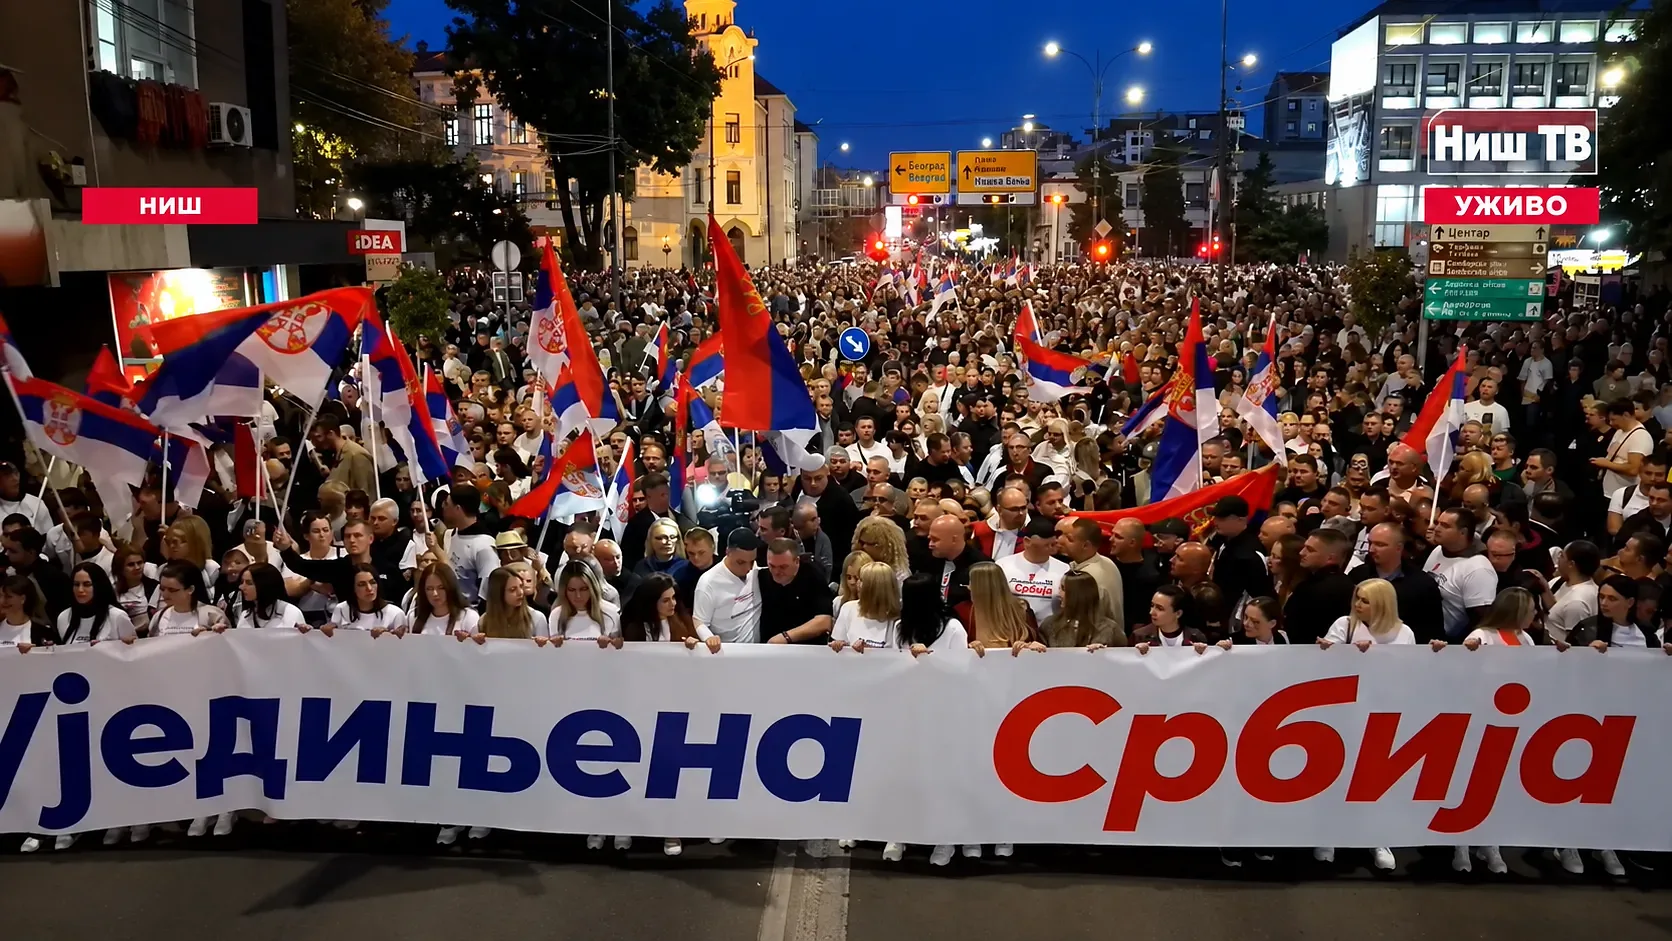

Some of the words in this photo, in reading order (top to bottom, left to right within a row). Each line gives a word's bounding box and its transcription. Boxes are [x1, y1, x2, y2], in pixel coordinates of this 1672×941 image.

[909, 161, 945, 172] Београд
[1448, 227, 1490, 239] Центар
[1014, 583, 1053, 596] Србија
[993, 675, 1637, 834] Србија
